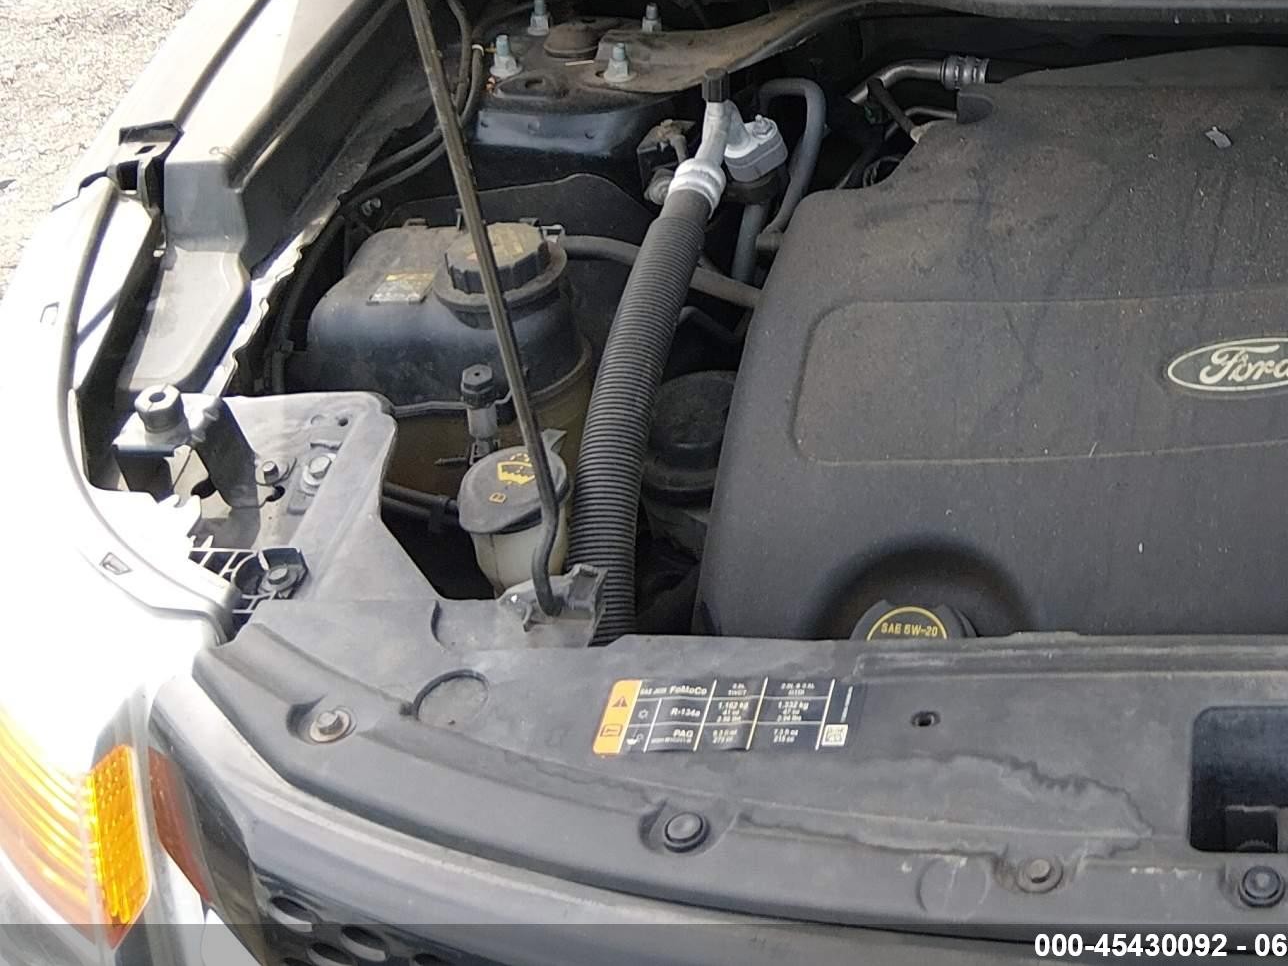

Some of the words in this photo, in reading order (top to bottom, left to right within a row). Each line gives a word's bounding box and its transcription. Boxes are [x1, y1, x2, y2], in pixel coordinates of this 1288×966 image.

[881, 622, 901, 635] SAE
[669, 685, 707, 695] FoMoCo
[670, 707, 701, 717] R-134a
